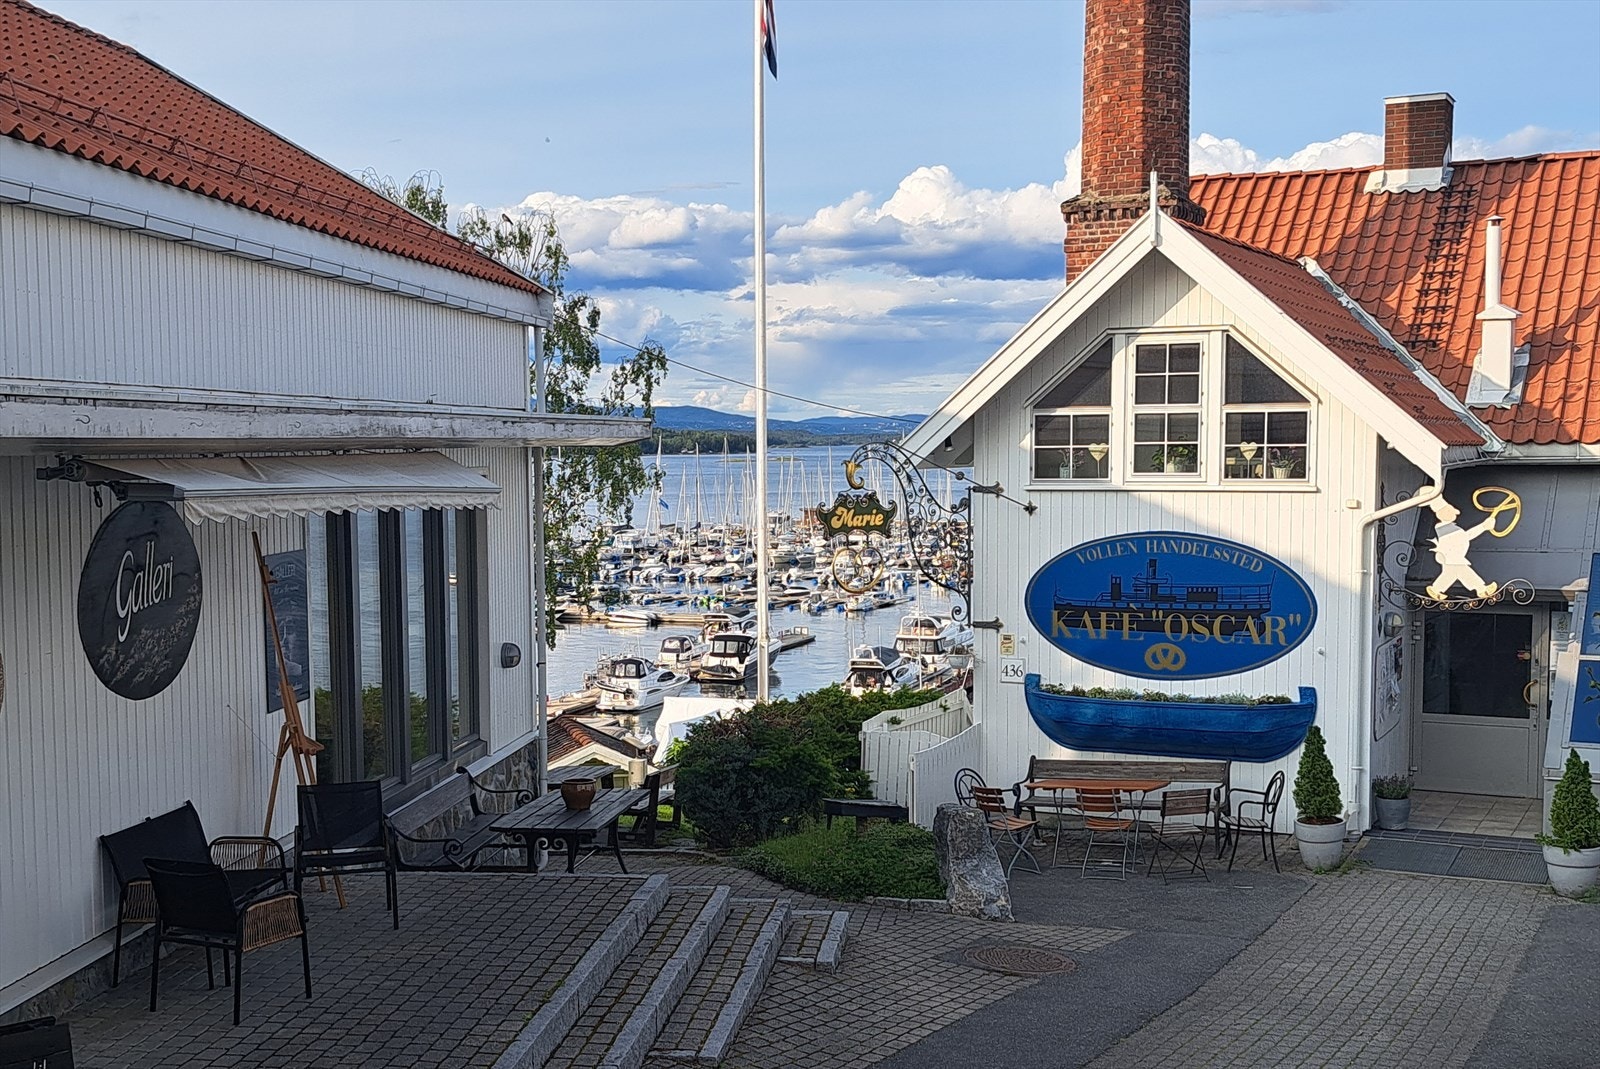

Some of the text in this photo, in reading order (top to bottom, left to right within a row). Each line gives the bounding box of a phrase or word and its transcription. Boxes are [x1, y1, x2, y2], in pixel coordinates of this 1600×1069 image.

[832, 507, 884, 528] Marie
[1076, 539, 1263, 573] VOLLEN HANDELSSTED
[116, 541, 174, 642] Galleri
[1152, 609, 1301, 646] "OSCAR"
[1001, 664, 1023, 678] 436
